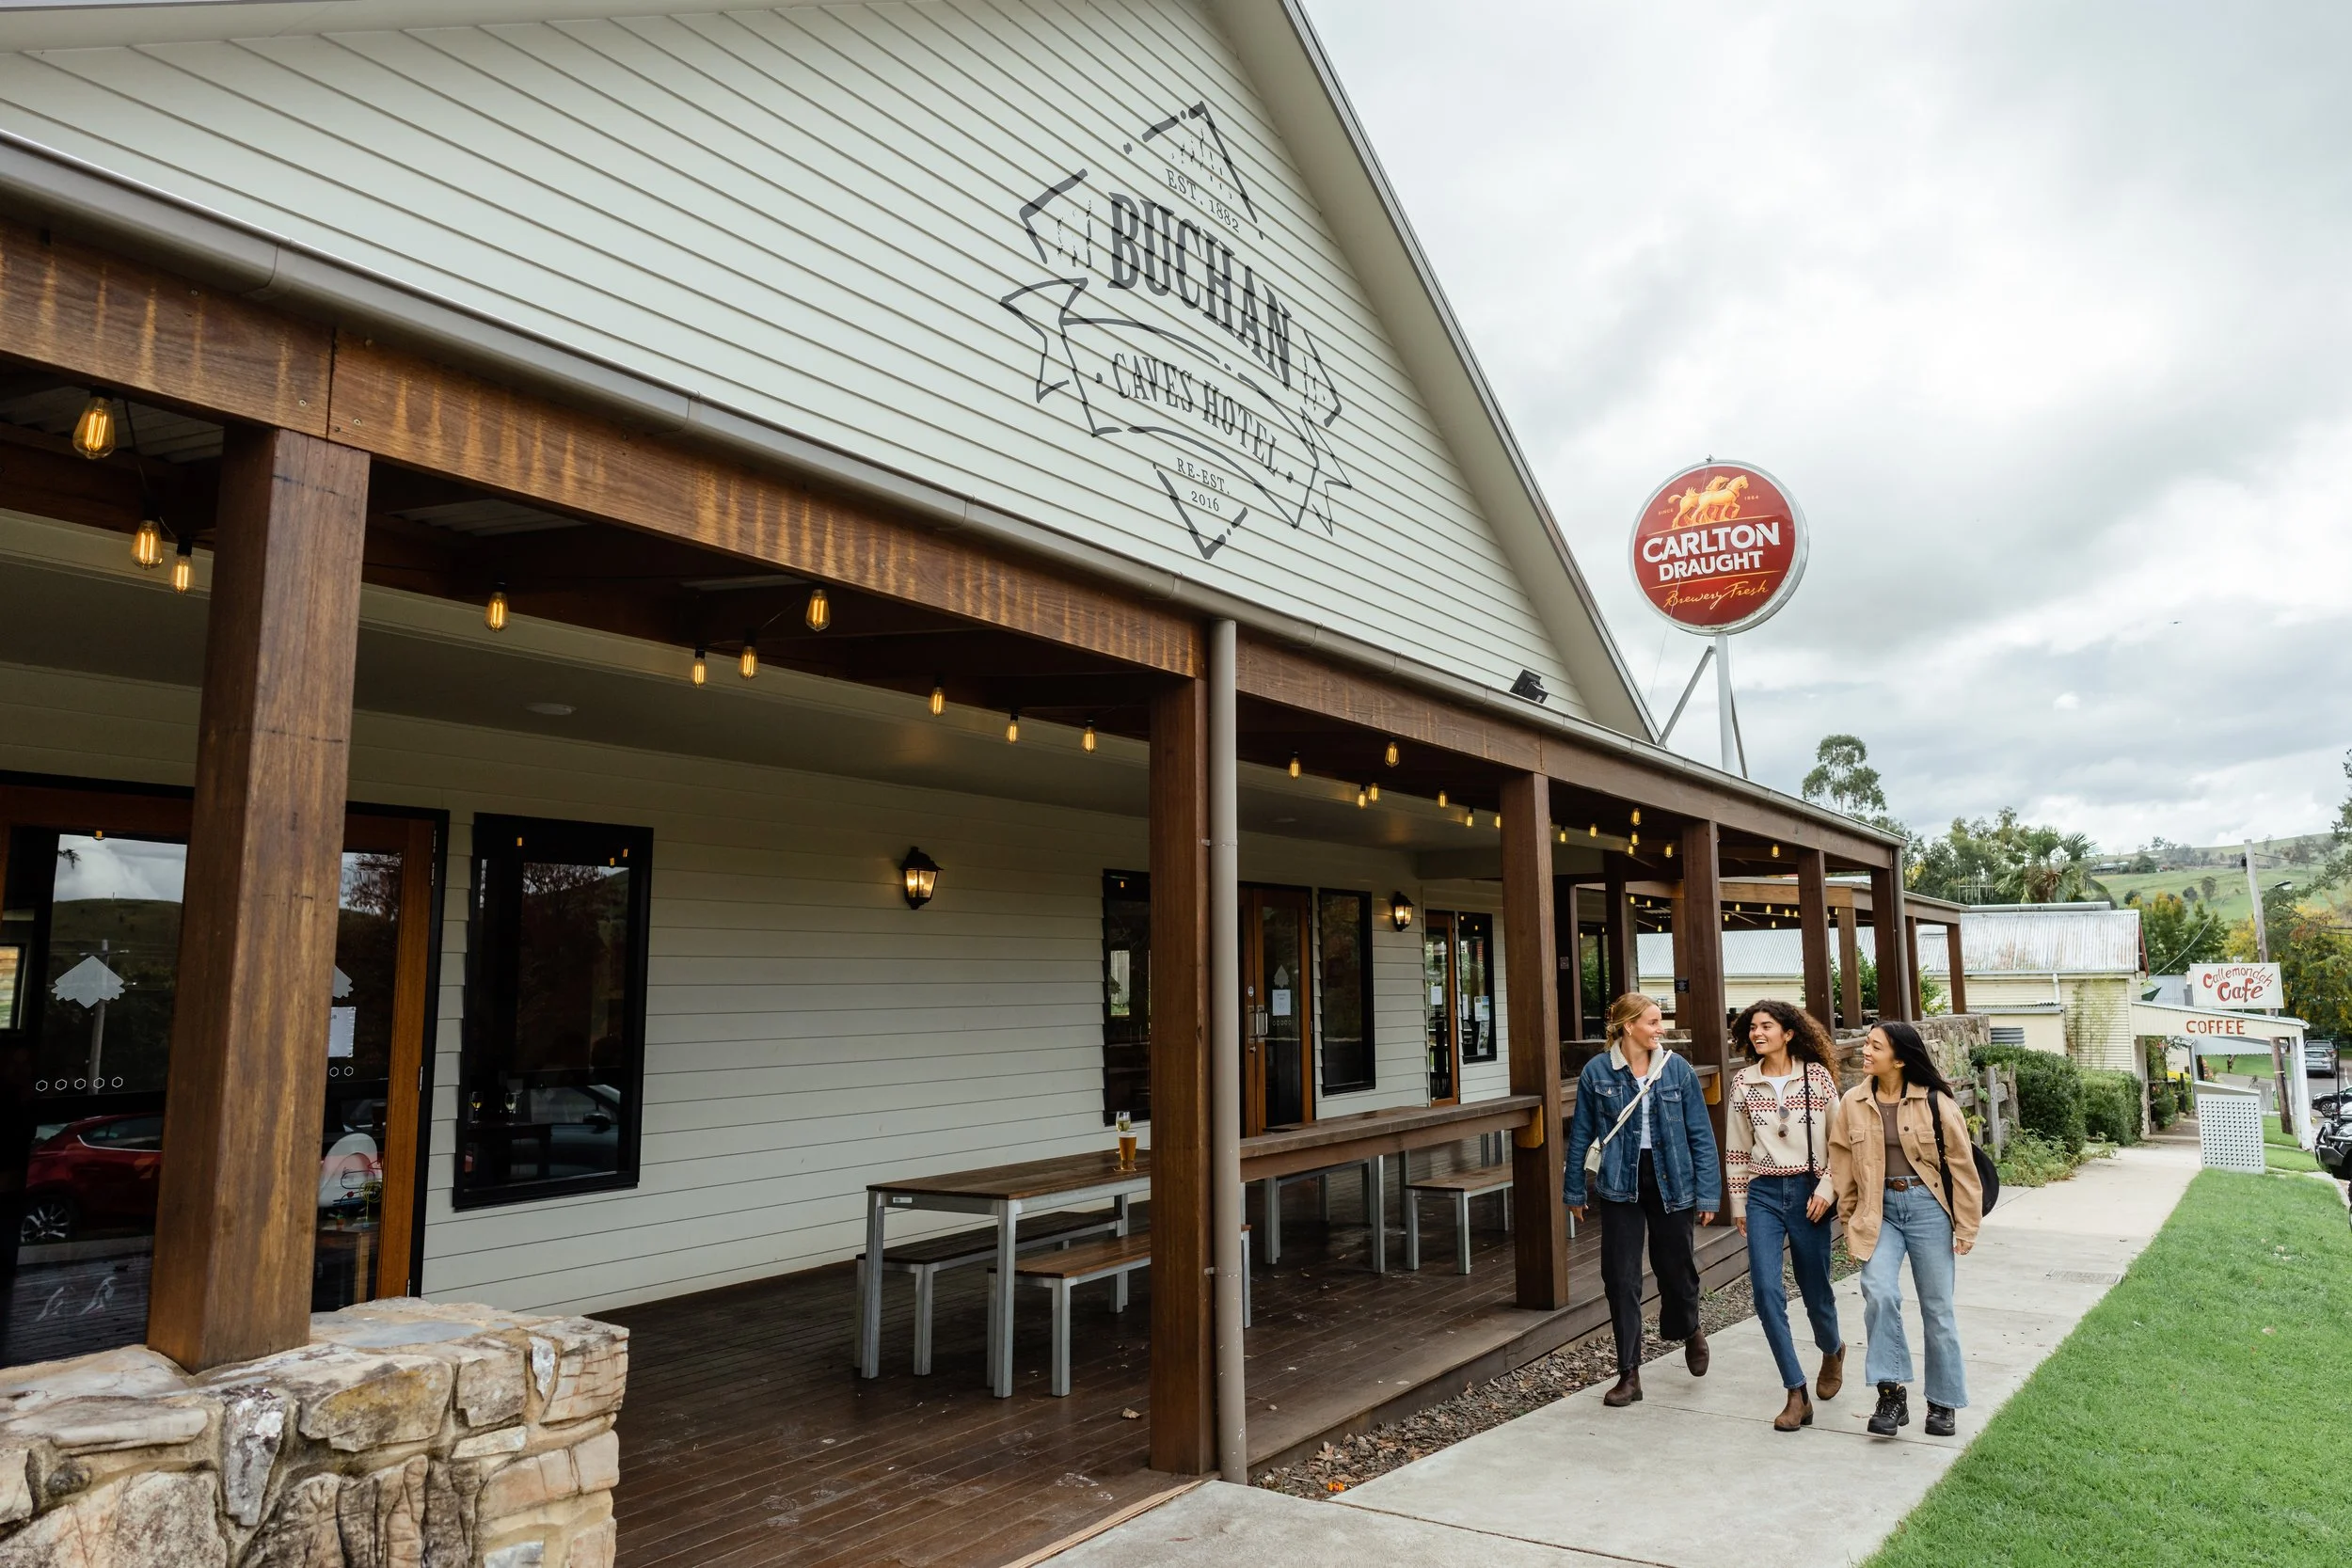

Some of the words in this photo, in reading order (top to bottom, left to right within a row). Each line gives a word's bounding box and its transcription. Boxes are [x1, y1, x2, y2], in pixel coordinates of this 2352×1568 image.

[1209, 199, 1240, 233] 1882
[1107, 191, 1293, 391] BUCHAN
[1114, 352, 1194, 414] CAVES
[1202, 379, 1279, 474] HOTEL
[1177, 457, 1231, 495] RE-EST.
[1191, 490, 1220, 512] 2016
[1643, 522, 1781, 562] CARLTON
[1659, 550, 1764, 581] DRAUGHT
[1663, 590, 1724, 610] Brewery
[1724, 579, 1770, 598] Fresh
[2202, 967, 2274, 989] Callemondah
[2217, 978, 2264, 1003] Café
[2185, 1020, 2246, 1035] COFFEE
